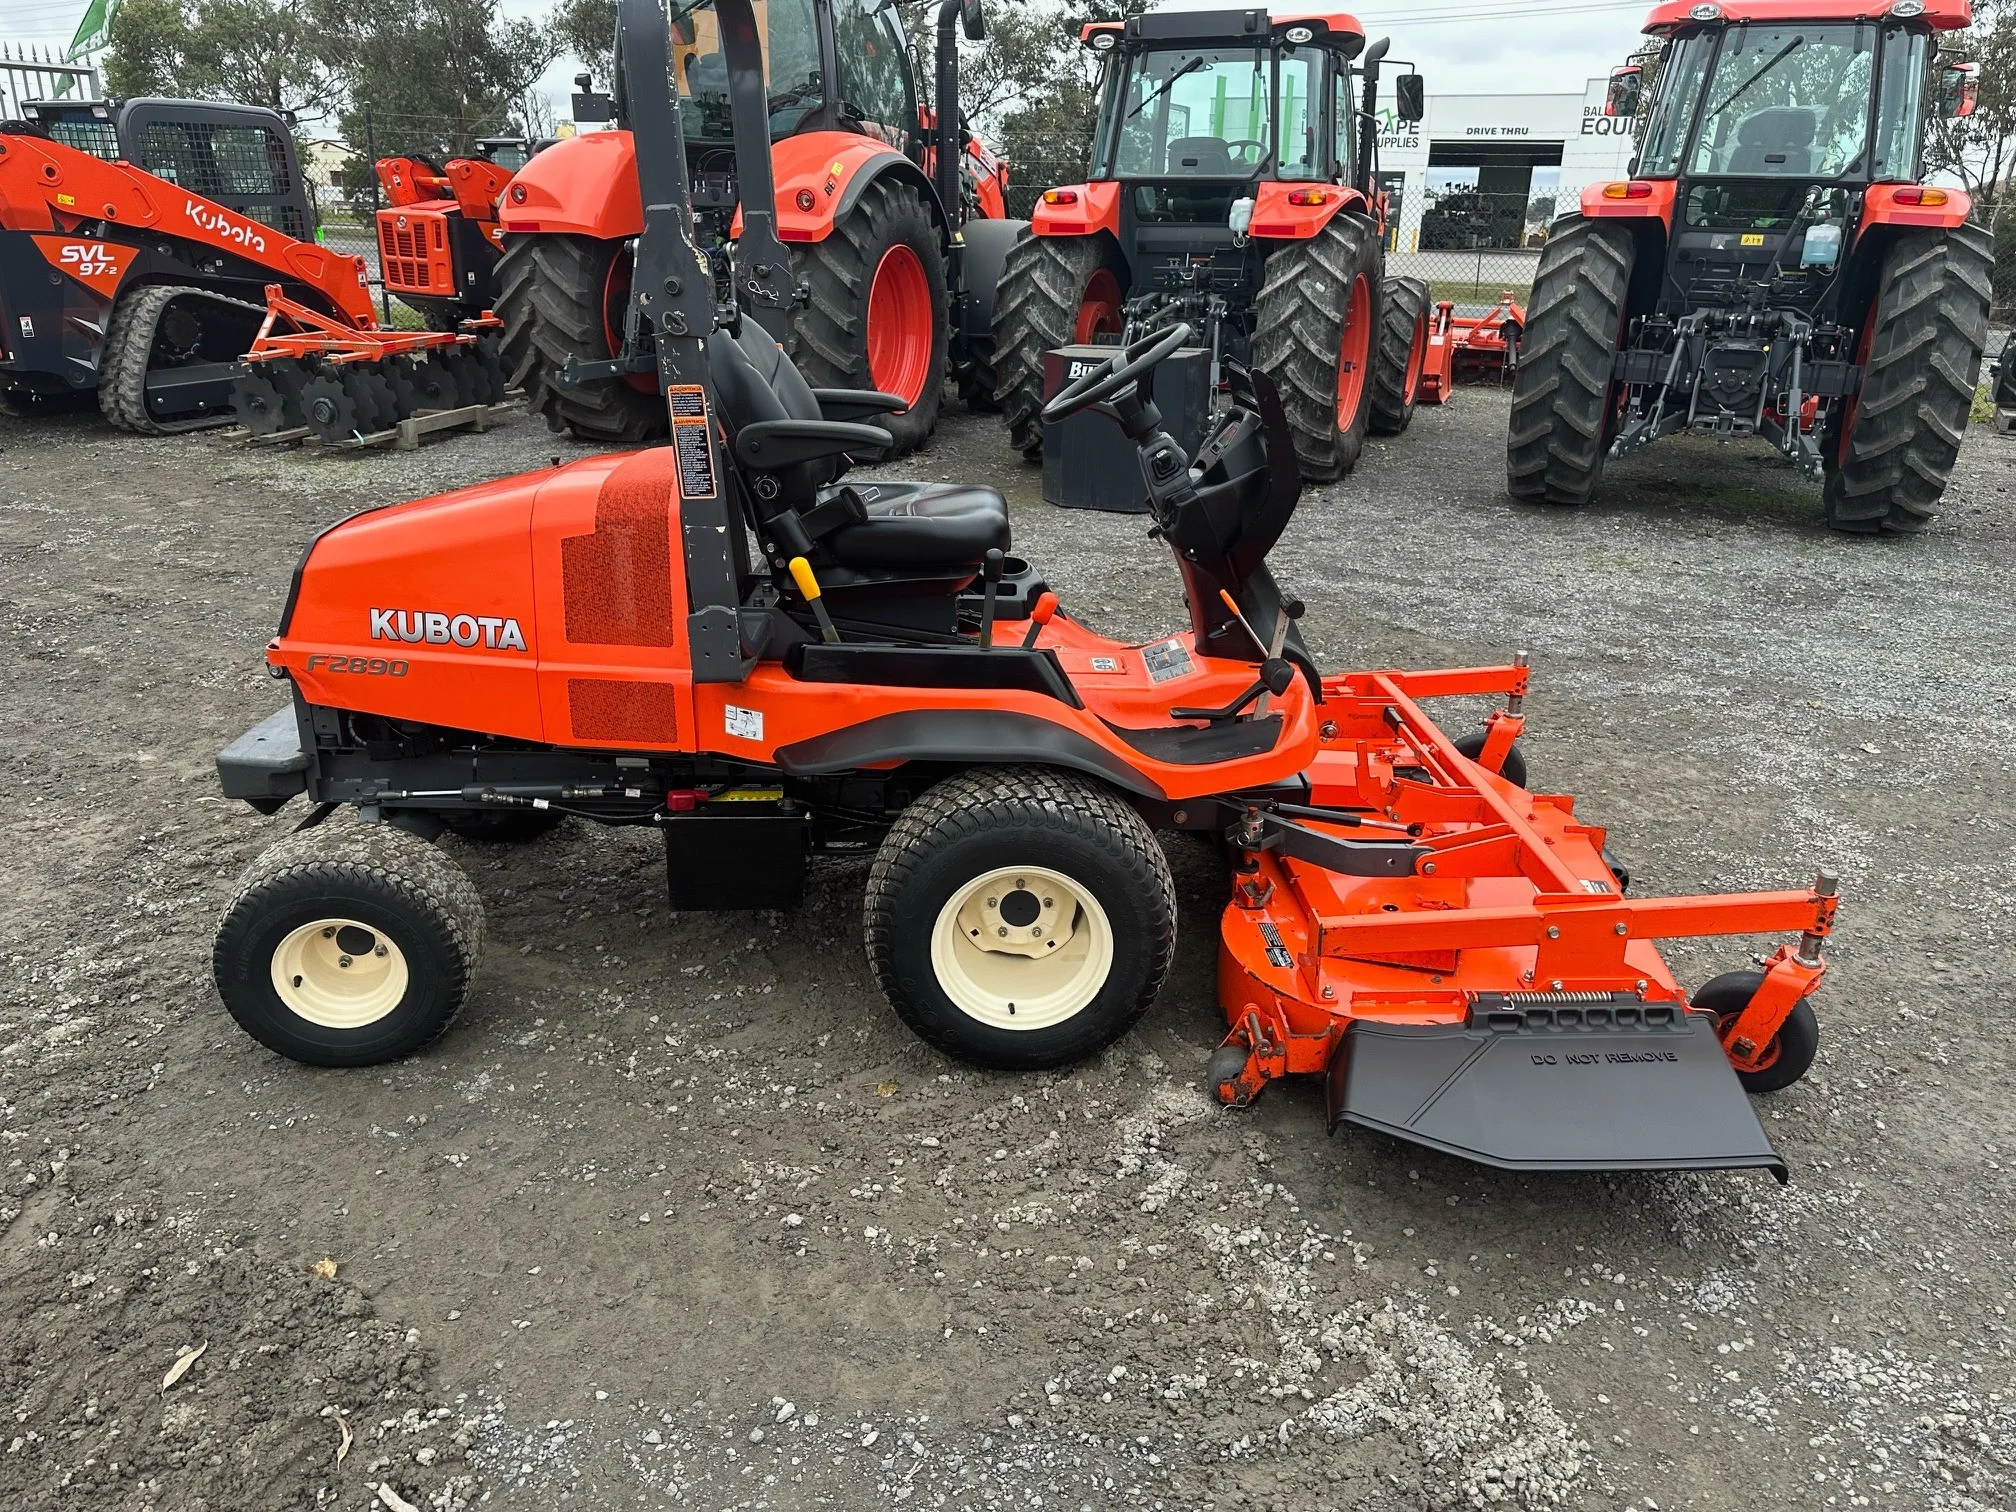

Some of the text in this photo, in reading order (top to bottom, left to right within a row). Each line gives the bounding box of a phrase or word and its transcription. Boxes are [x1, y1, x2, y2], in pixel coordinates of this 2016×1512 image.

[1583, 106, 1605, 117] BAL
[1466, 127, 1530, 136] DRIVE THRU
[1581, 117, 1634, 136] EQUI
[1375, 137, 1419, 148] UPPLIES
[185, 200, 266, 253] Kubota
[60, 244, 115, 263] SVL
[79, 262, 118, 276] 97-2
[369, 607, 528, 651] KUBOTA
[306, 653, 410, 678] F2890
[1530, 1051, 1679, 1066] DO NOT REMOVE
